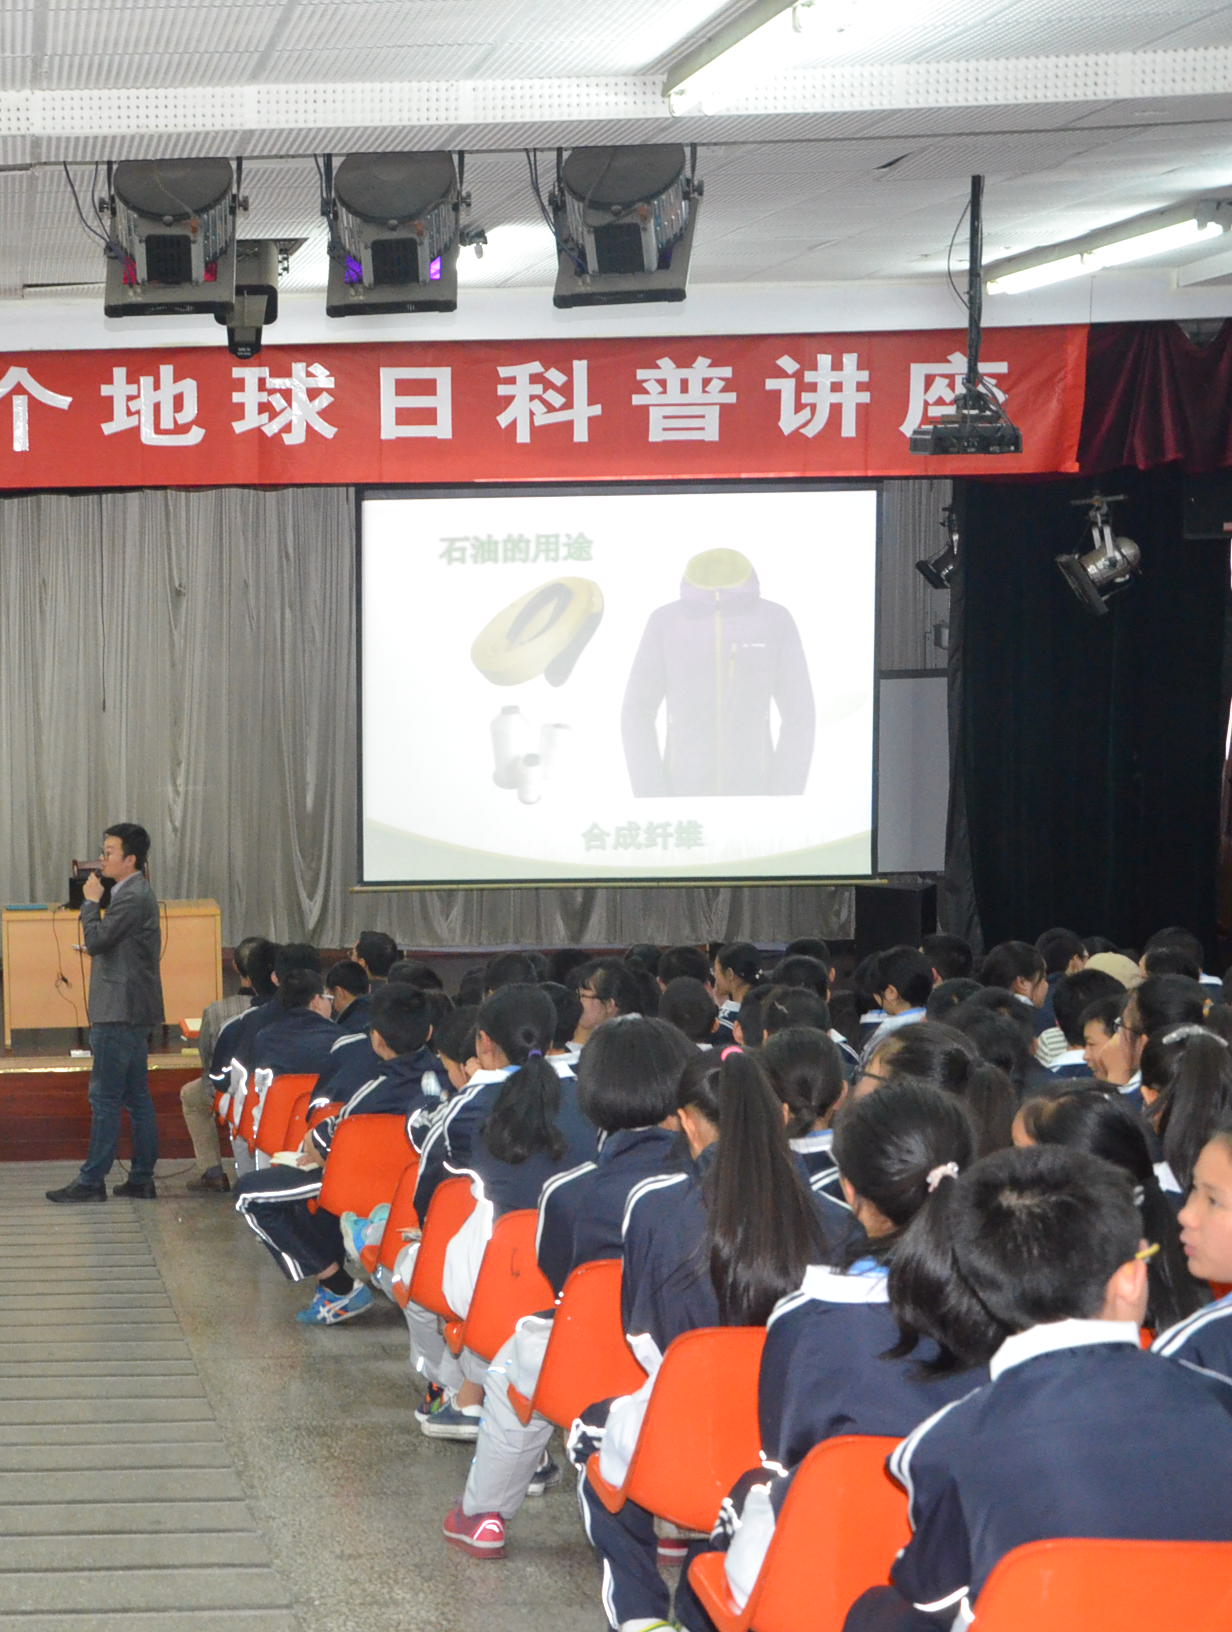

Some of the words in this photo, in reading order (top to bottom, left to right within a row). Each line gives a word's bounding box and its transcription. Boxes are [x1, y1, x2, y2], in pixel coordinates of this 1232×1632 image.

[438, 531, 594, 566] 石油的用途
[581, 819, 706, 852] 合成纤维
